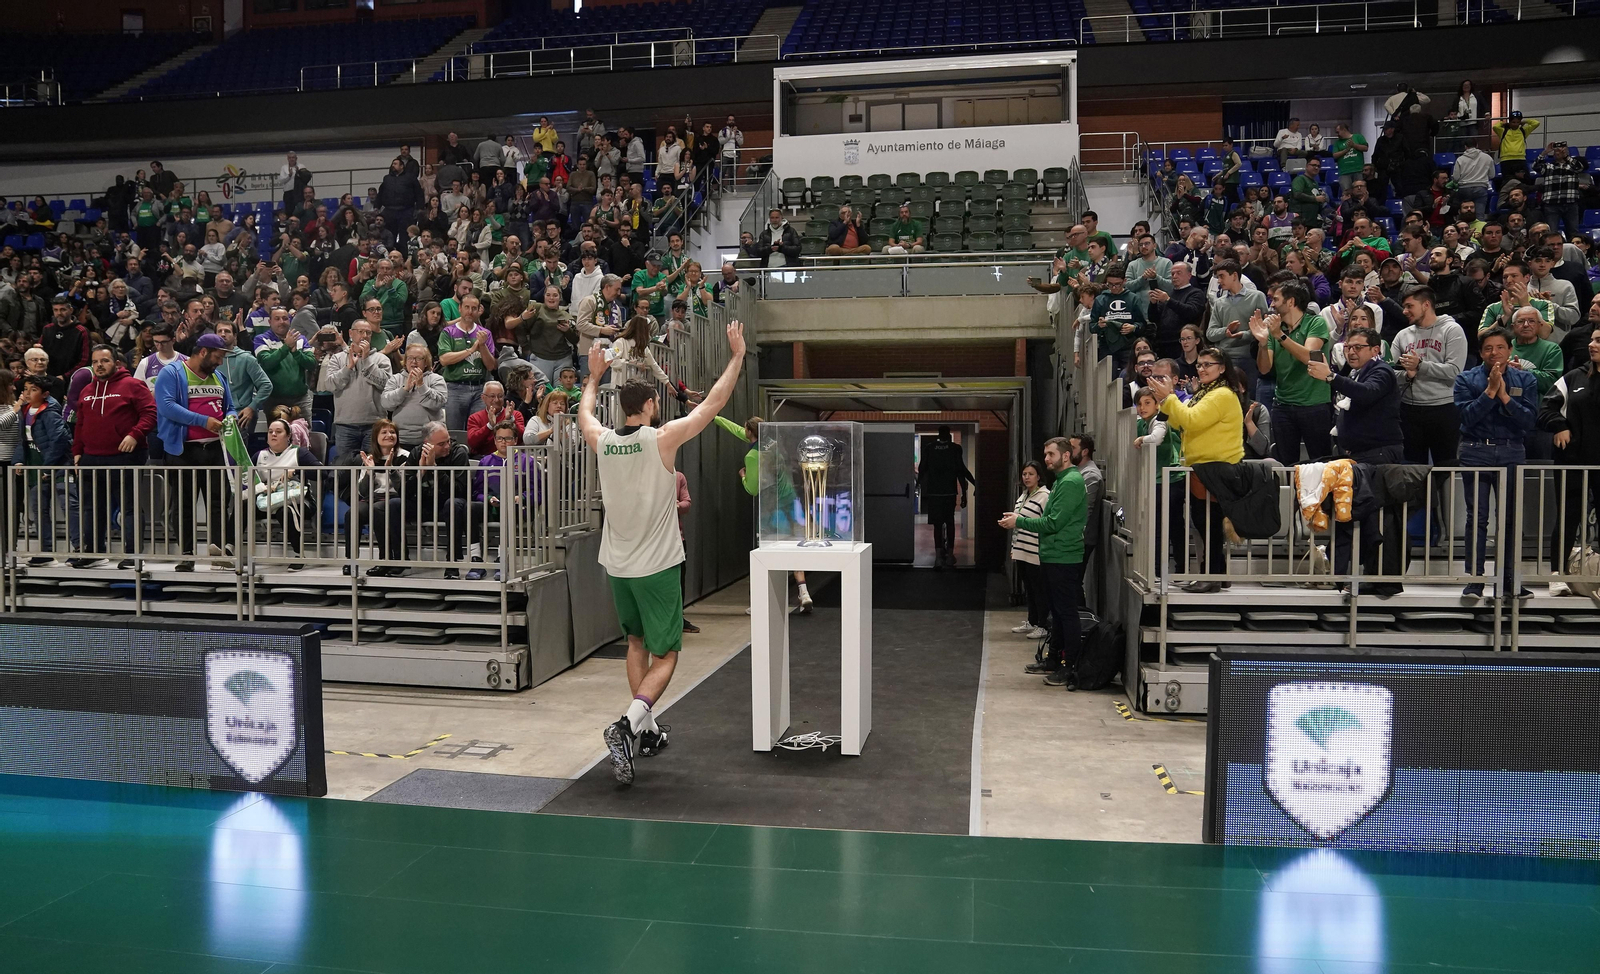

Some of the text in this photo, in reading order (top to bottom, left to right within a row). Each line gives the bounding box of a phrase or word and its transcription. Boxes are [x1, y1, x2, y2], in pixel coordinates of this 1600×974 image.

[866, 137, 1006, 155] Ayuntamiento de Málaga
[1416, 338, 1442, 353] ANGELES
[603, 442, 643, 456] Joma
